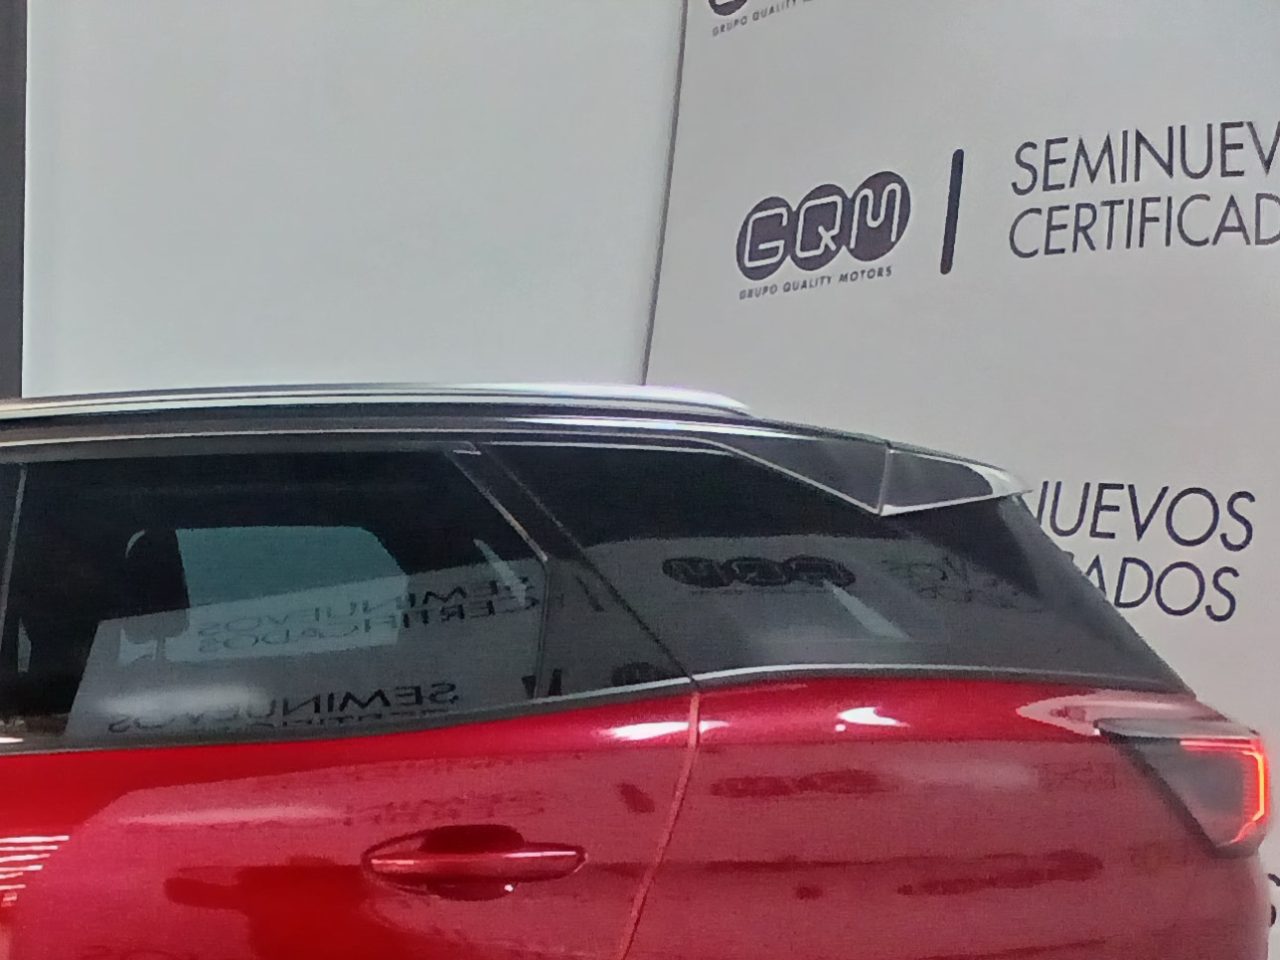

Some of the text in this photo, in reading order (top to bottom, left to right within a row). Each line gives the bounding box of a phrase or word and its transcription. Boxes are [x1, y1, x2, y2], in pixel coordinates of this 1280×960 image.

[1011, 121, 1280, 196] SEMINUEV
[741, 179, 905, 270] GQM
[739, 266, 893, 300] GRUPO QUALITY MOTORS
[1082, 554, 1240, 622] ADOS
